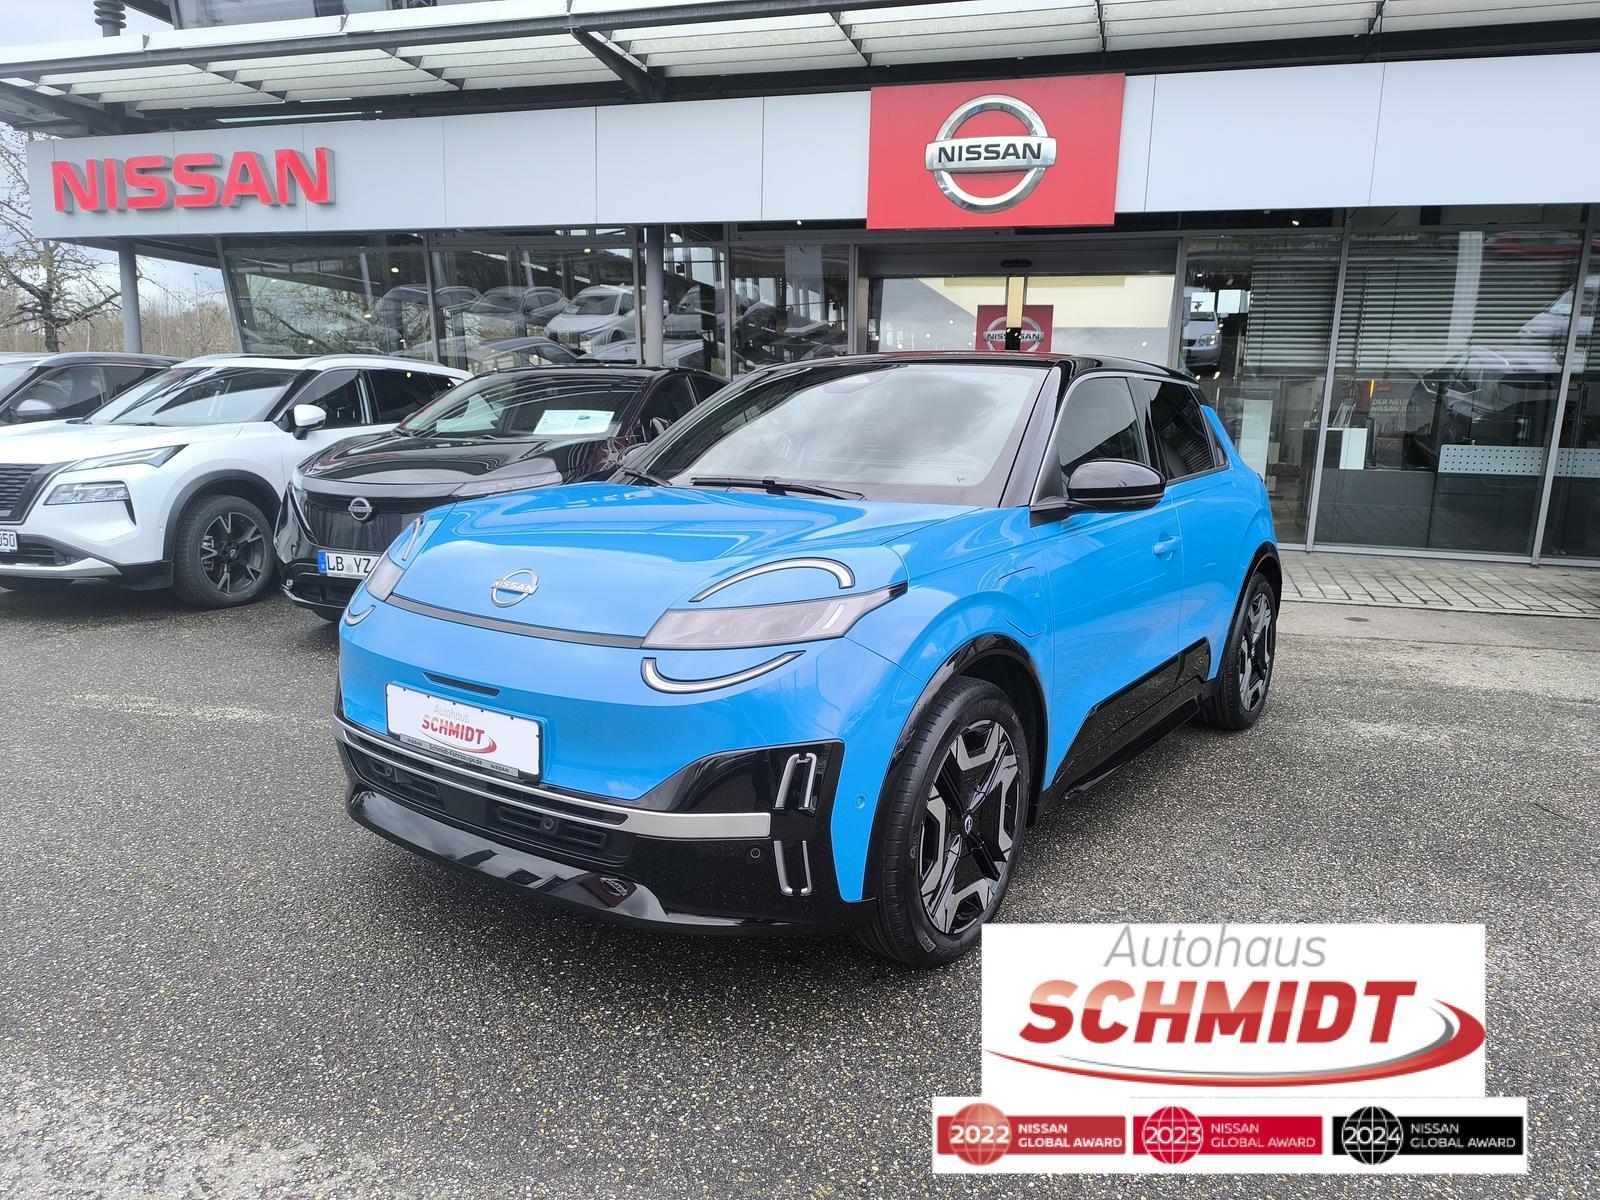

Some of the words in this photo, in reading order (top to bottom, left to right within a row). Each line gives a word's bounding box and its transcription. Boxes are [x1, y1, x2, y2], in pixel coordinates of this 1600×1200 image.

[938, 143, 1042, 163] NISSAN
[51, 147, 334, 213] NISSAN
[327, 555, 344, 571] LB
[354, 557, 371, 573] YZ
[434, 705, 469, 723] Autohaus
[422, 715, 484, 744] SCHMIDT
[490, 763, 509, 774] NISSAN
